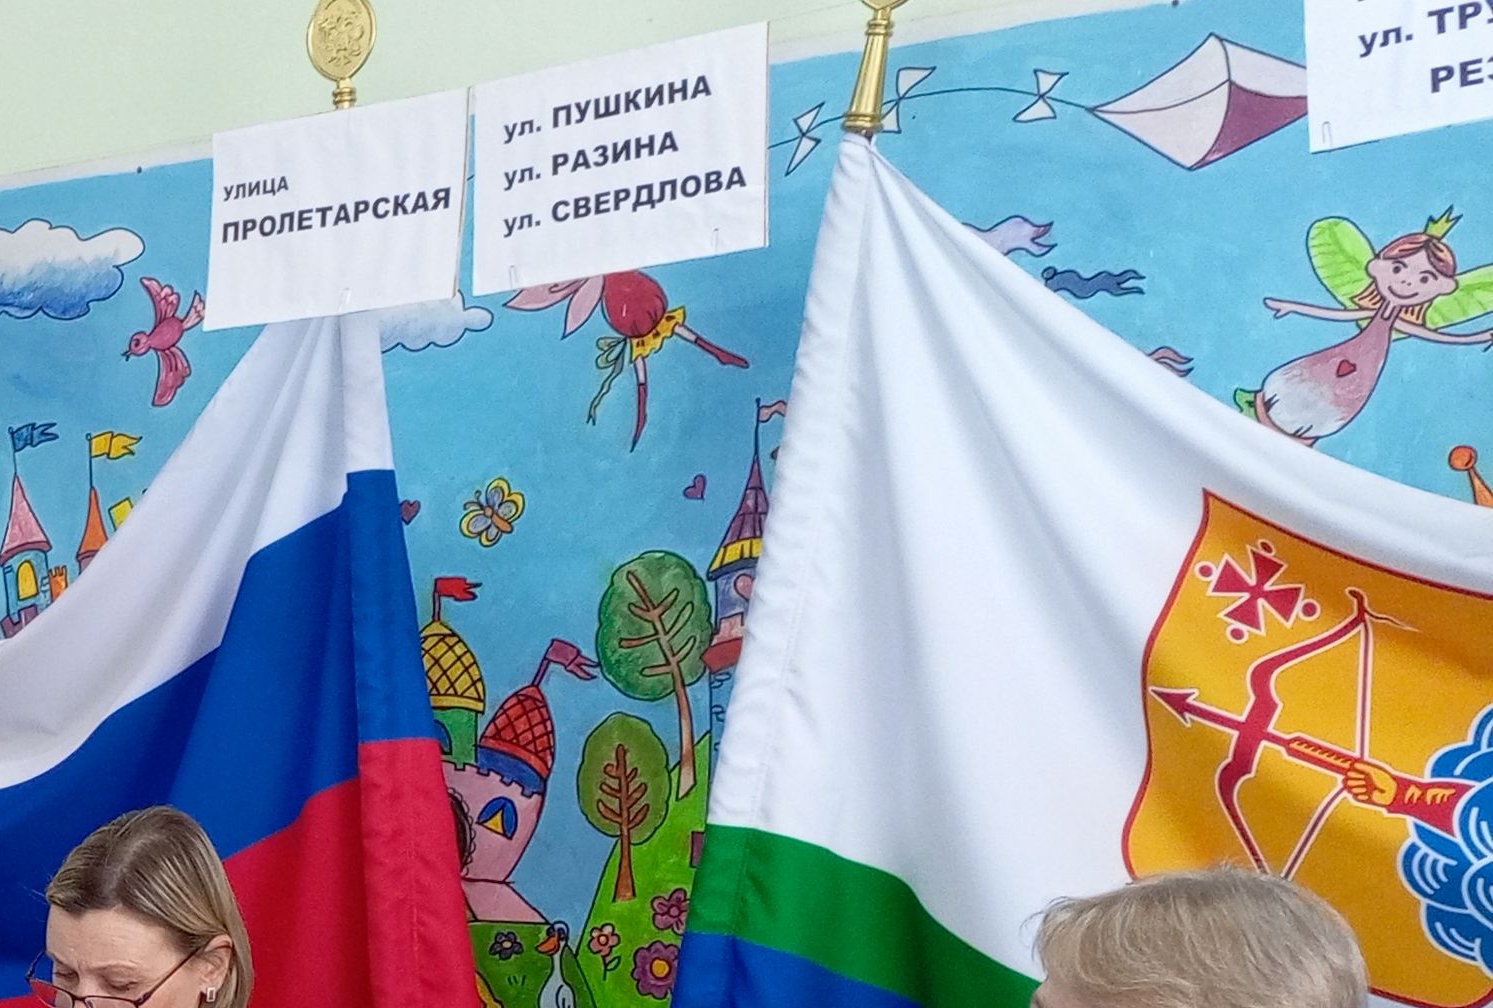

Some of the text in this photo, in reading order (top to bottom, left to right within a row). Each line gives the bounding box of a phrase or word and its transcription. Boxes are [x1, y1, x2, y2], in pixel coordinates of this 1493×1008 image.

[1359, 26, 1414, 58] ул.
[503, 75, 712, 145] ул. ПУШКИНА
[223, 176, 289, 202] УЛИЦА
[503, 130, 680, 192] ул. РАЗИНА
[222, 187, 451, 244] ПРОЛЕТАРСКАЯ
[503, 166, 747, 238] ул. СВЕРДЛОВА
